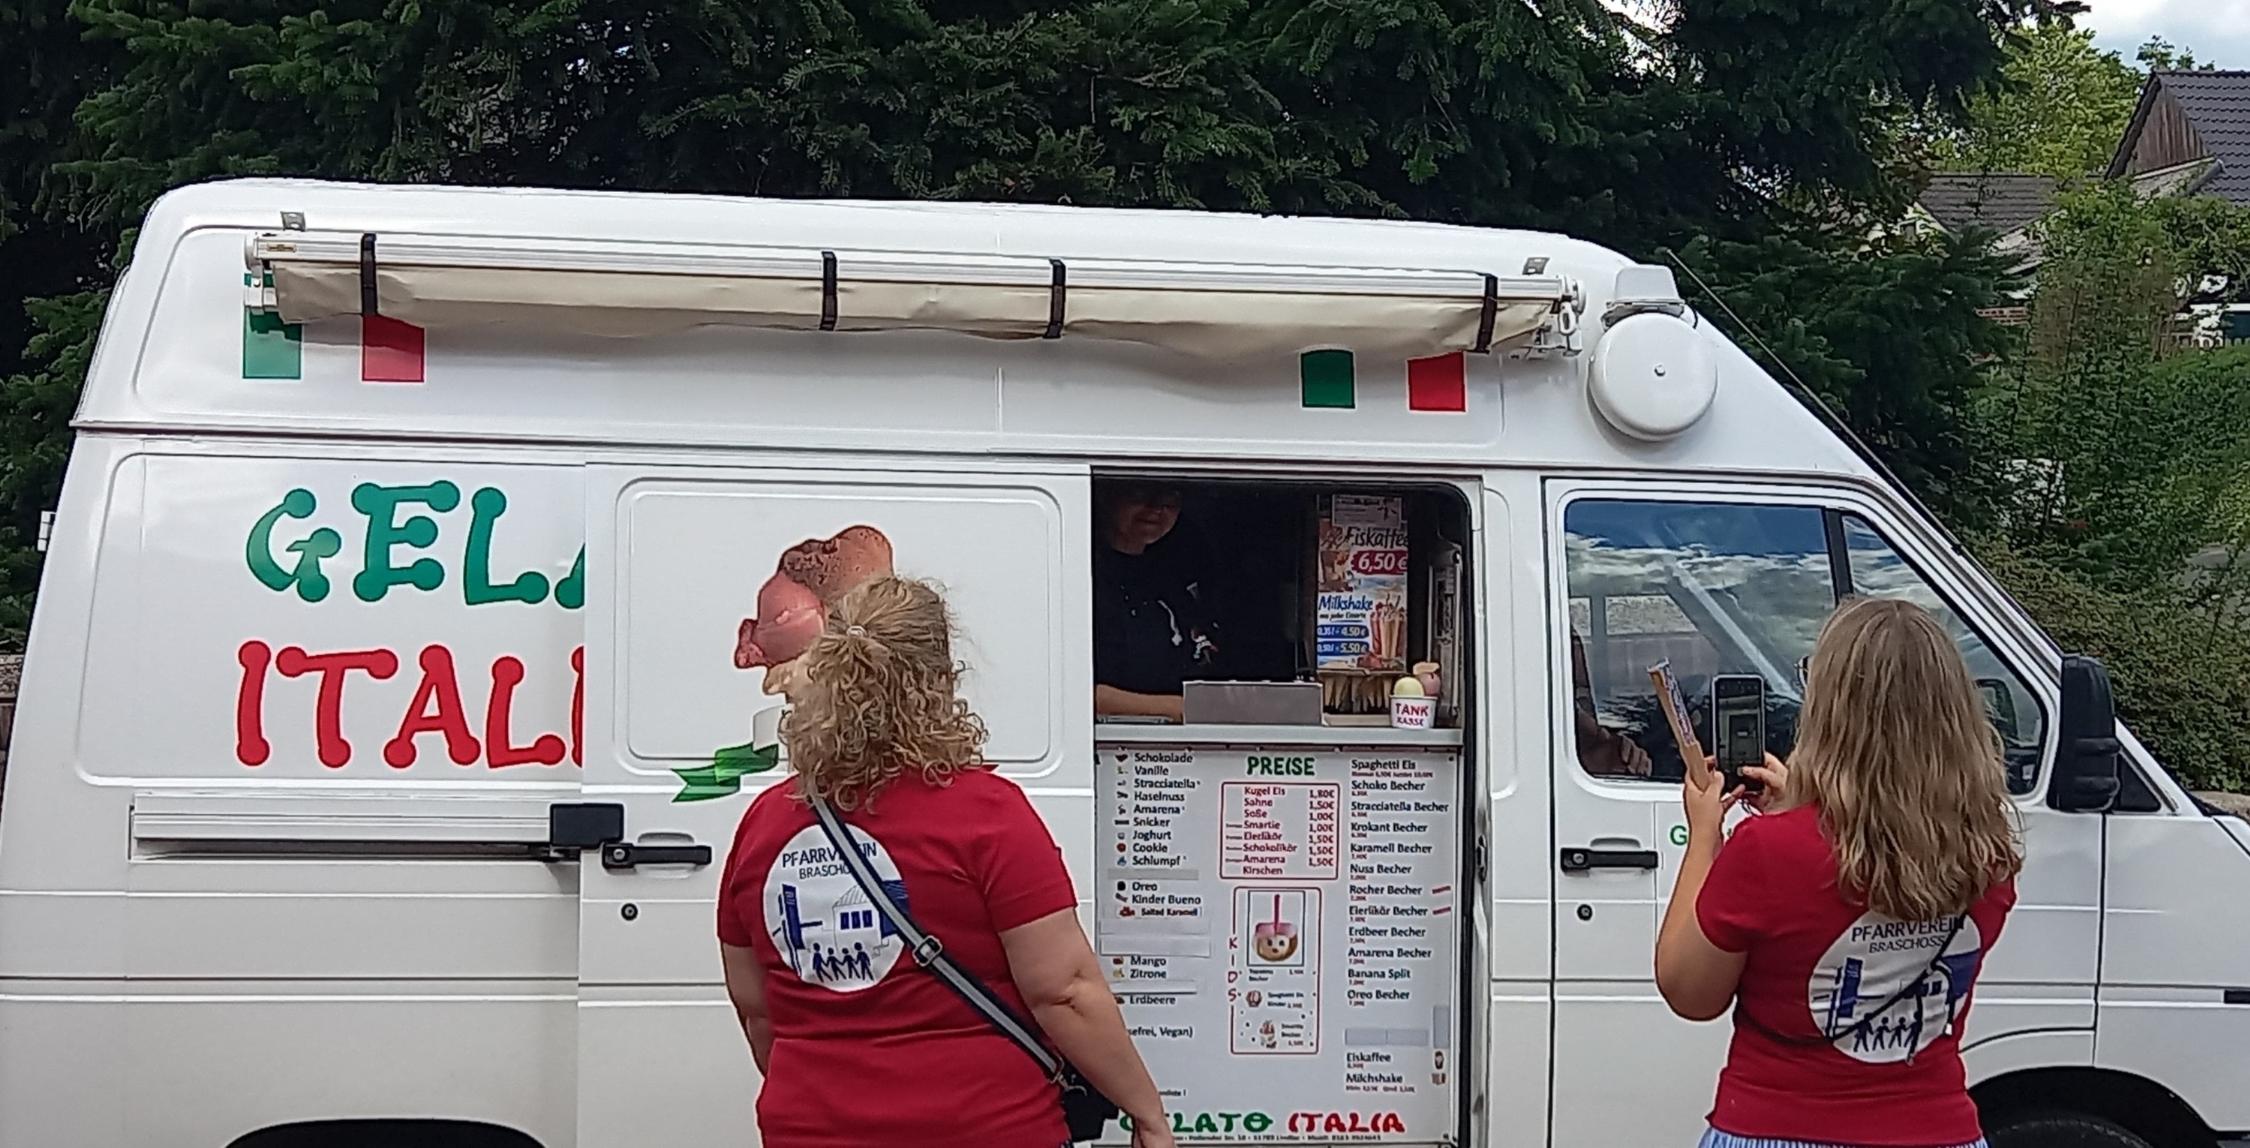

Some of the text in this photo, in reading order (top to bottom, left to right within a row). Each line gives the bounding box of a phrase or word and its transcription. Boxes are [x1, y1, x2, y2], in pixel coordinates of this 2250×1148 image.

[1358, 553, 1395, 572] 6,50
[1319, 595, 1373, 611] Milkshake
[1396, 703, 1428, 716] TANK
[1134, 752, 1193, 763] Schokolade
[1247, 756, 1315, 775] PREISE
[1351, 759, 1416, 770] Spaghetti Eis
[1134, 766, 1169, 775] Vanille
[1351, 780, 1425, 790] Schoko Becher
[1134, 791, 1185, 801] Haselnuss
[1244, 786, 1270, 796] Kugel
[1273, 787, 1285, 796] Eis
[1244, 797, 1334, 810] Sahne 1,50€
[1351, 801, 1449, 812] Stracciatella Becher
[1244, 809, 1334, 822] Soße 1,00€
[1133, 817, 1170, 827] Snicker
[1243, 820, 1334, 833] Smartie 1,00€
[1351, 821, 1428, 832] Krokant Becher
[1132, 830, 1172, 841] Joghurt
[1243, 831, 1334, 844] Eierlikör 1,50€
[1132, 843, 1168, 853] Cookie
[1243, 843, 1334, 856] Schokolikör 1,50€
[1350, 843, 1432, 854] Karamell Becher
[1243, 855, 1334, 867] Amarena 1,50€
[1243, 866, 1283, 875] Kirschen
[1350, 864, 1412, 874] Nuss Becher
[1132, 882, 1157, 891] Oreo
[1350, 885, 1422, 895] Rocher Becher
[1132, 894, 1201, 905] Kinder Bueno
[1349, 905, 1428, 916] Eierlikör Becher
[1349, 927, 1426, 937] Erdbeer Becher
[1869, 935, 1946, 953] BRASCHOSS
[1348, 947, 1432, 958] Amarena Becher
[1130, 956, 1166, 967] Mango
[1130, 969, 1166, 979] Zitrone
[1348, 968, 1411, 979] Banana Split
[1347, 989, 1410, 999] Oreo Becher
[1159, 1026, 1193, 1038] Vegan)
[1347, 1052, 1391, 1062] Eiskaffee
[1346, 1073, 1403, 1083] Milchshake
[1288, 1112, 1405, 1132] ITALIA
